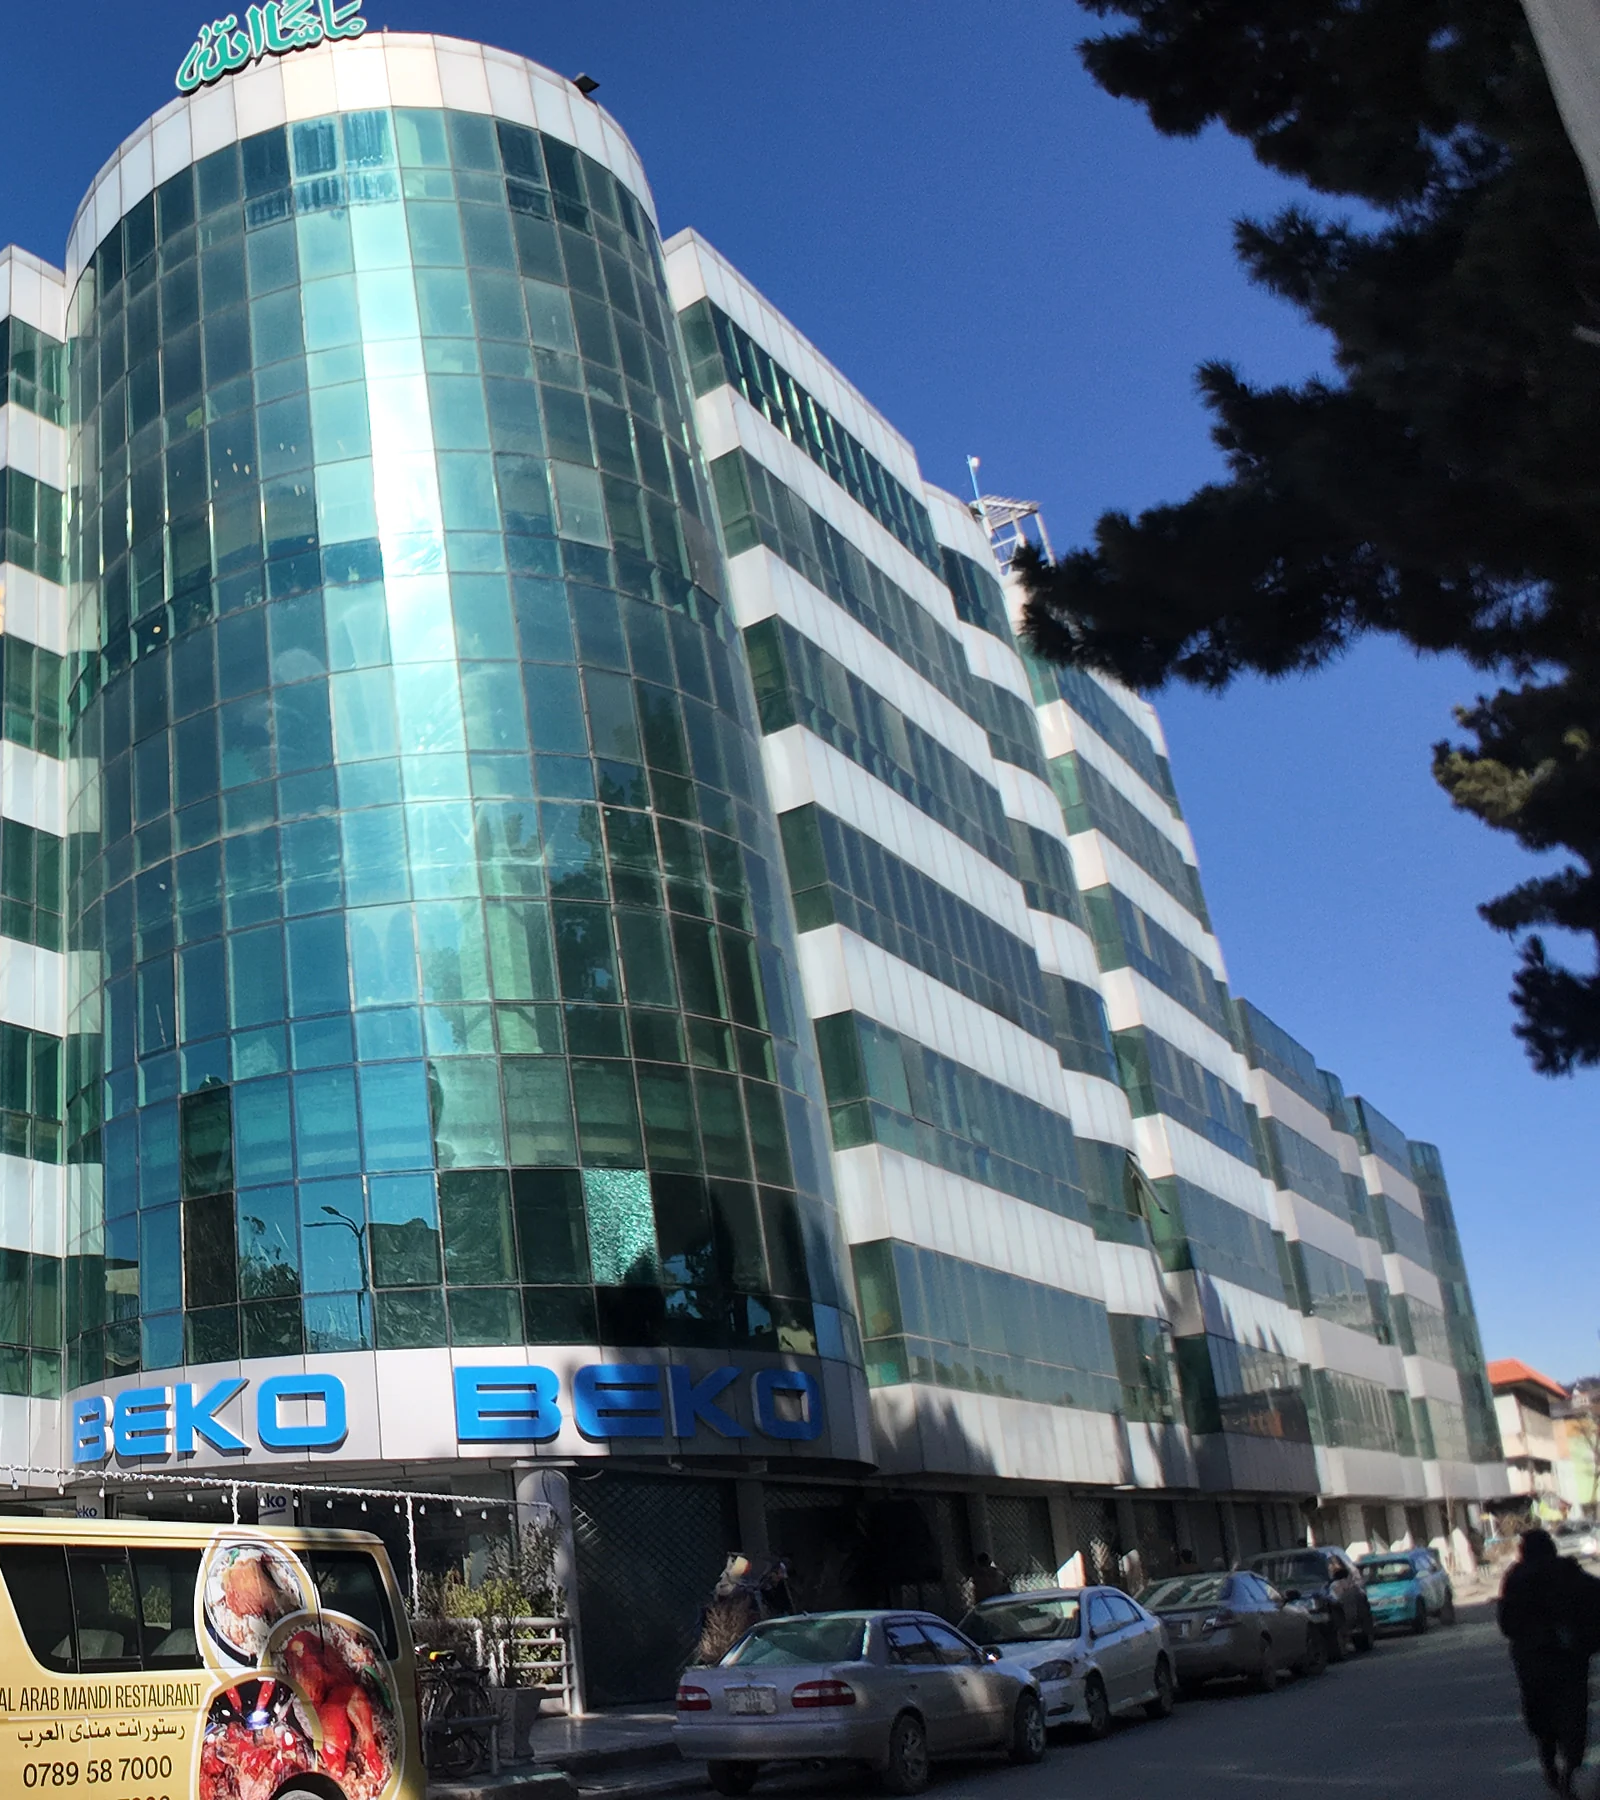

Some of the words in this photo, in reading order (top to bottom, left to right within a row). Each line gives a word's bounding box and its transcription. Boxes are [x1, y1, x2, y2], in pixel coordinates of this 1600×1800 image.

[454, 1364, 823, 1441] BEKO
[72, 1374, 348, 1464] BEKO
[19, 1686, 60, 1711] ARAB
[63, 1684, 113, 1711] MANDI
[115, 1683, 201, 1709] RESTAURANT
[17, 1721, 64, 1748] العرب
[69, 1720, 111, 1743] مندی
[115, 1717, 186, 1742] رستورانت
[23, 1761, 80, 1788] 0789
[86, 1758, 113, 1784] 58
[118, 1754, 173, 1781] 7000
